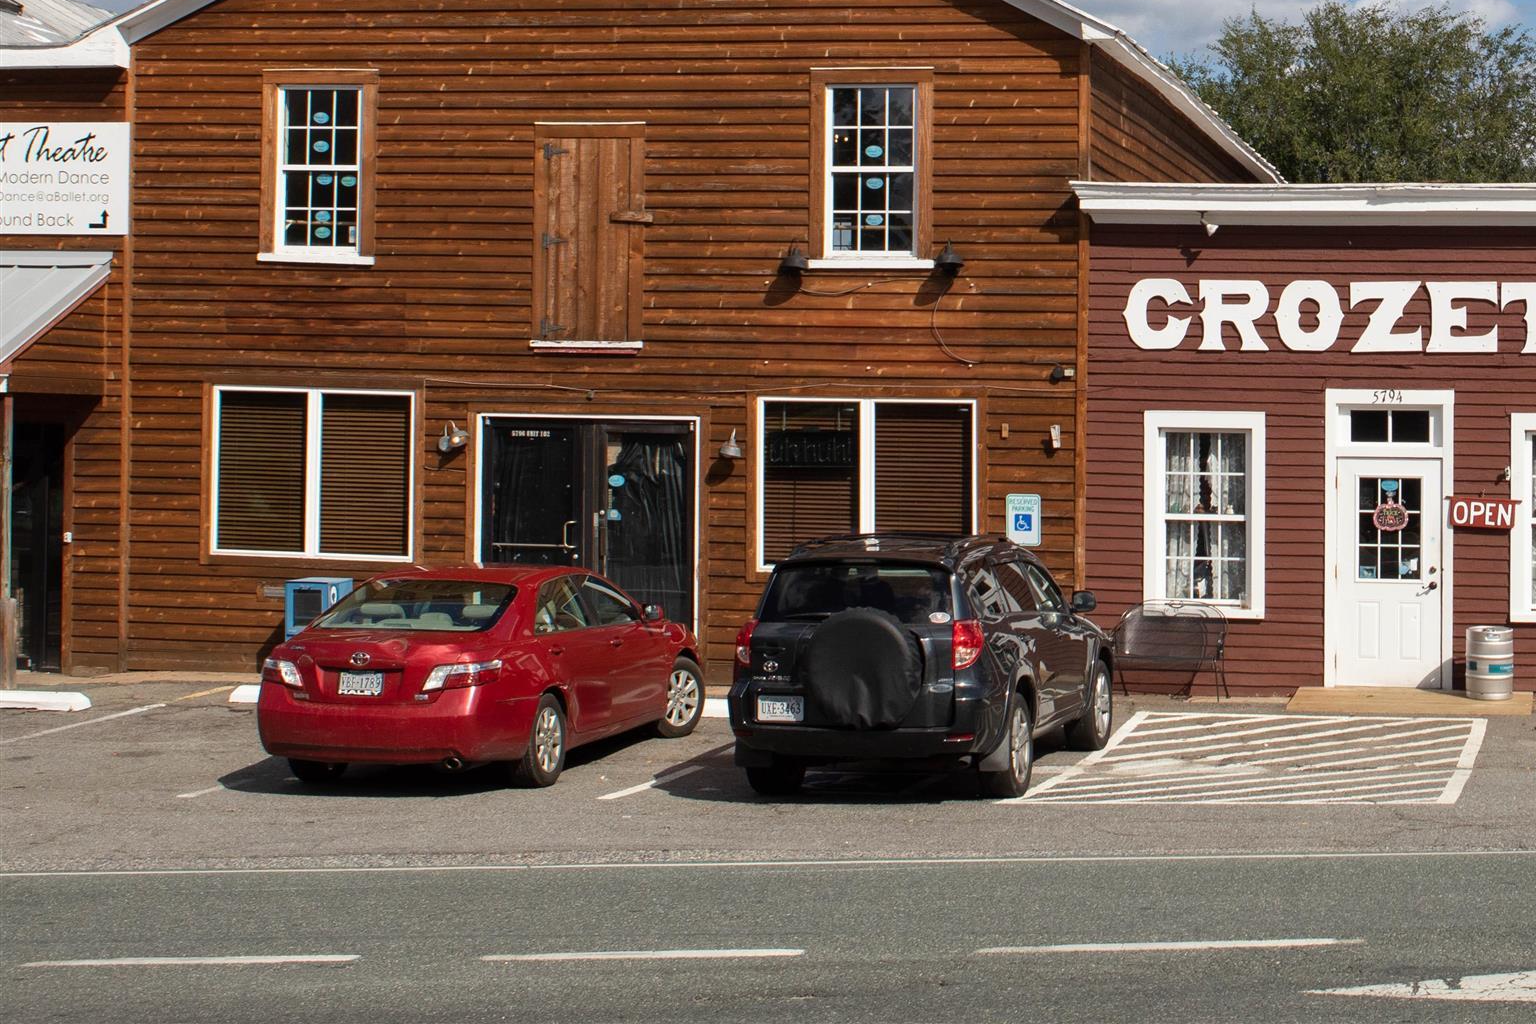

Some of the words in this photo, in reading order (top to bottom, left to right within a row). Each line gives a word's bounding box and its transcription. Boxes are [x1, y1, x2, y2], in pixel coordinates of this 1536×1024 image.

[23, 125, 108, 163] Theatre
[58, 171, 109, 184] Dance
[0, 213, 32, 226] und
[37, 213, 73, 226] Back
[1371, 389, 1403, 404] 5794
[1453, 501, 1513, 526] OPEN
[761, 702, 801, 715] UXE-3463
